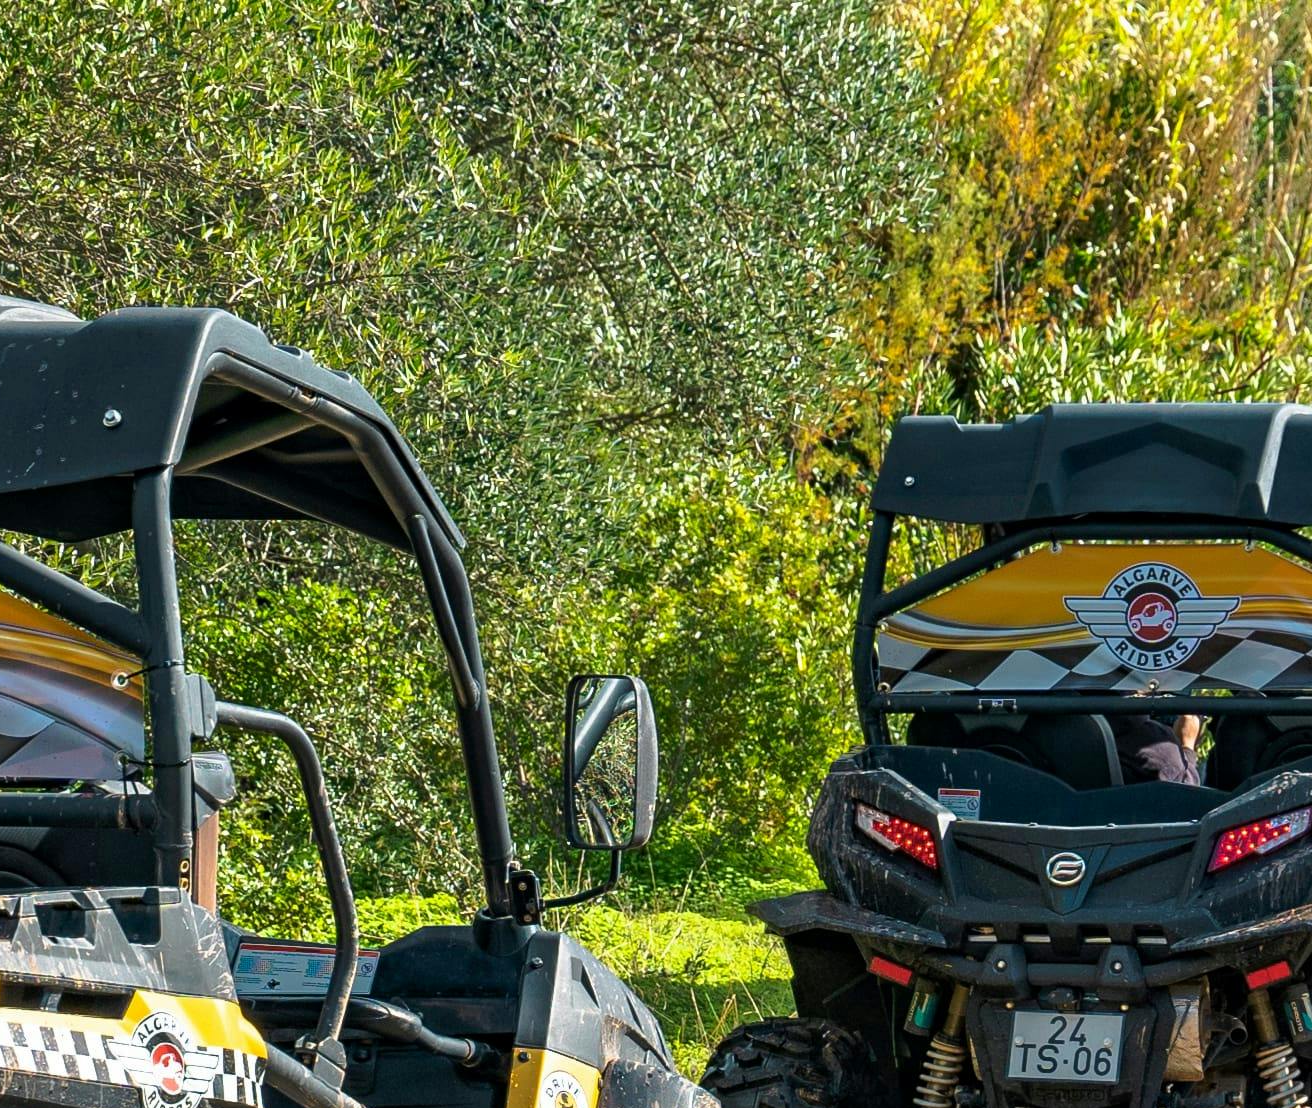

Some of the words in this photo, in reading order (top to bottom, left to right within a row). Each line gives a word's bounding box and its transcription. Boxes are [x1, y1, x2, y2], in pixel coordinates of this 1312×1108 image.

[1112, 567, 1193, 598] ALGARVE
[1114, 639, 1190, 667] RIDERS
[136, 1016, 191, 1045] ALGA
[1047, 1015, 1088, 1047] 24
